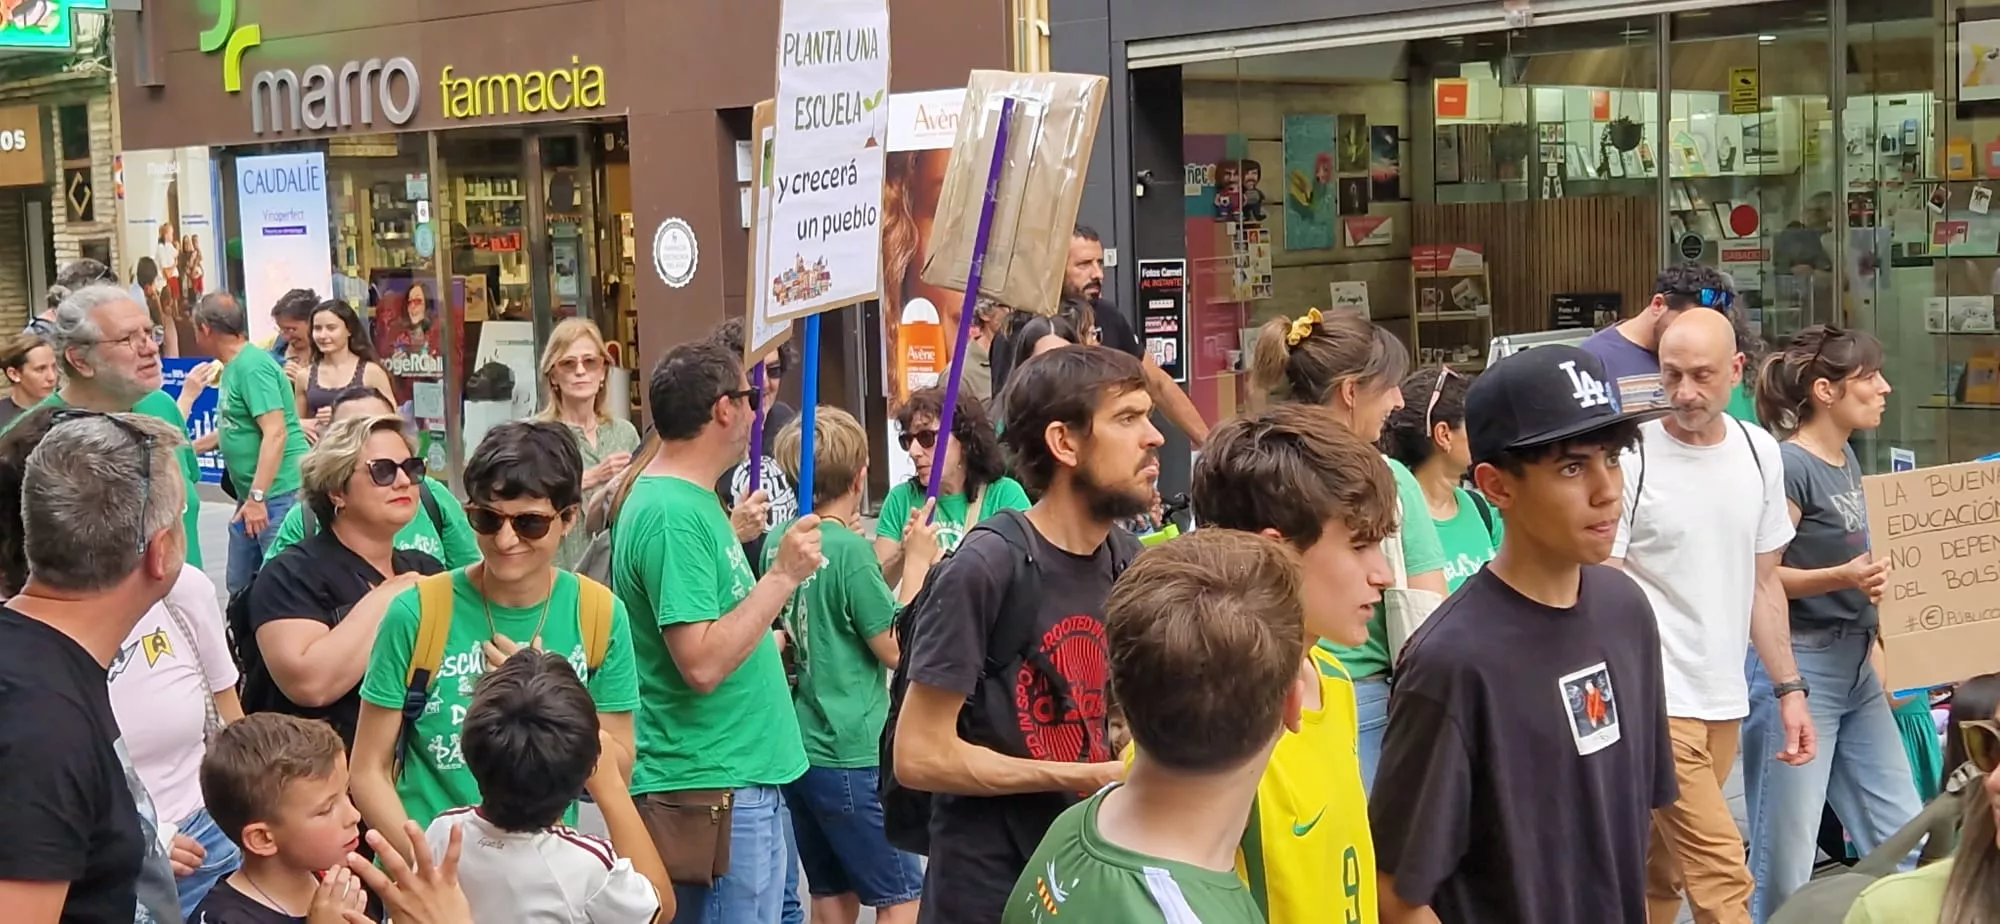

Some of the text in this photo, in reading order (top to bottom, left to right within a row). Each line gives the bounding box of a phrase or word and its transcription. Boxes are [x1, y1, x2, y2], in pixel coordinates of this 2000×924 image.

[783, 27, 878, 68] PLANTA UNA
[252, 54, 606, 134] marro farmacia
[795, 90, 861, 131] ESCUELA
[914, 103, 959, 130] Avèn
[778, 158, 858, 205] y crecerá
[797, 202, 877, 243] un pueblo
[1559, 360, 1609, 408] LA
[1882, 481, 1908, 508] LA
[1890, 545, 1921, 571] NO
[1894, 560, 2000, 601] DEL BOLS
[1343, 845, 1361, 924] 9
